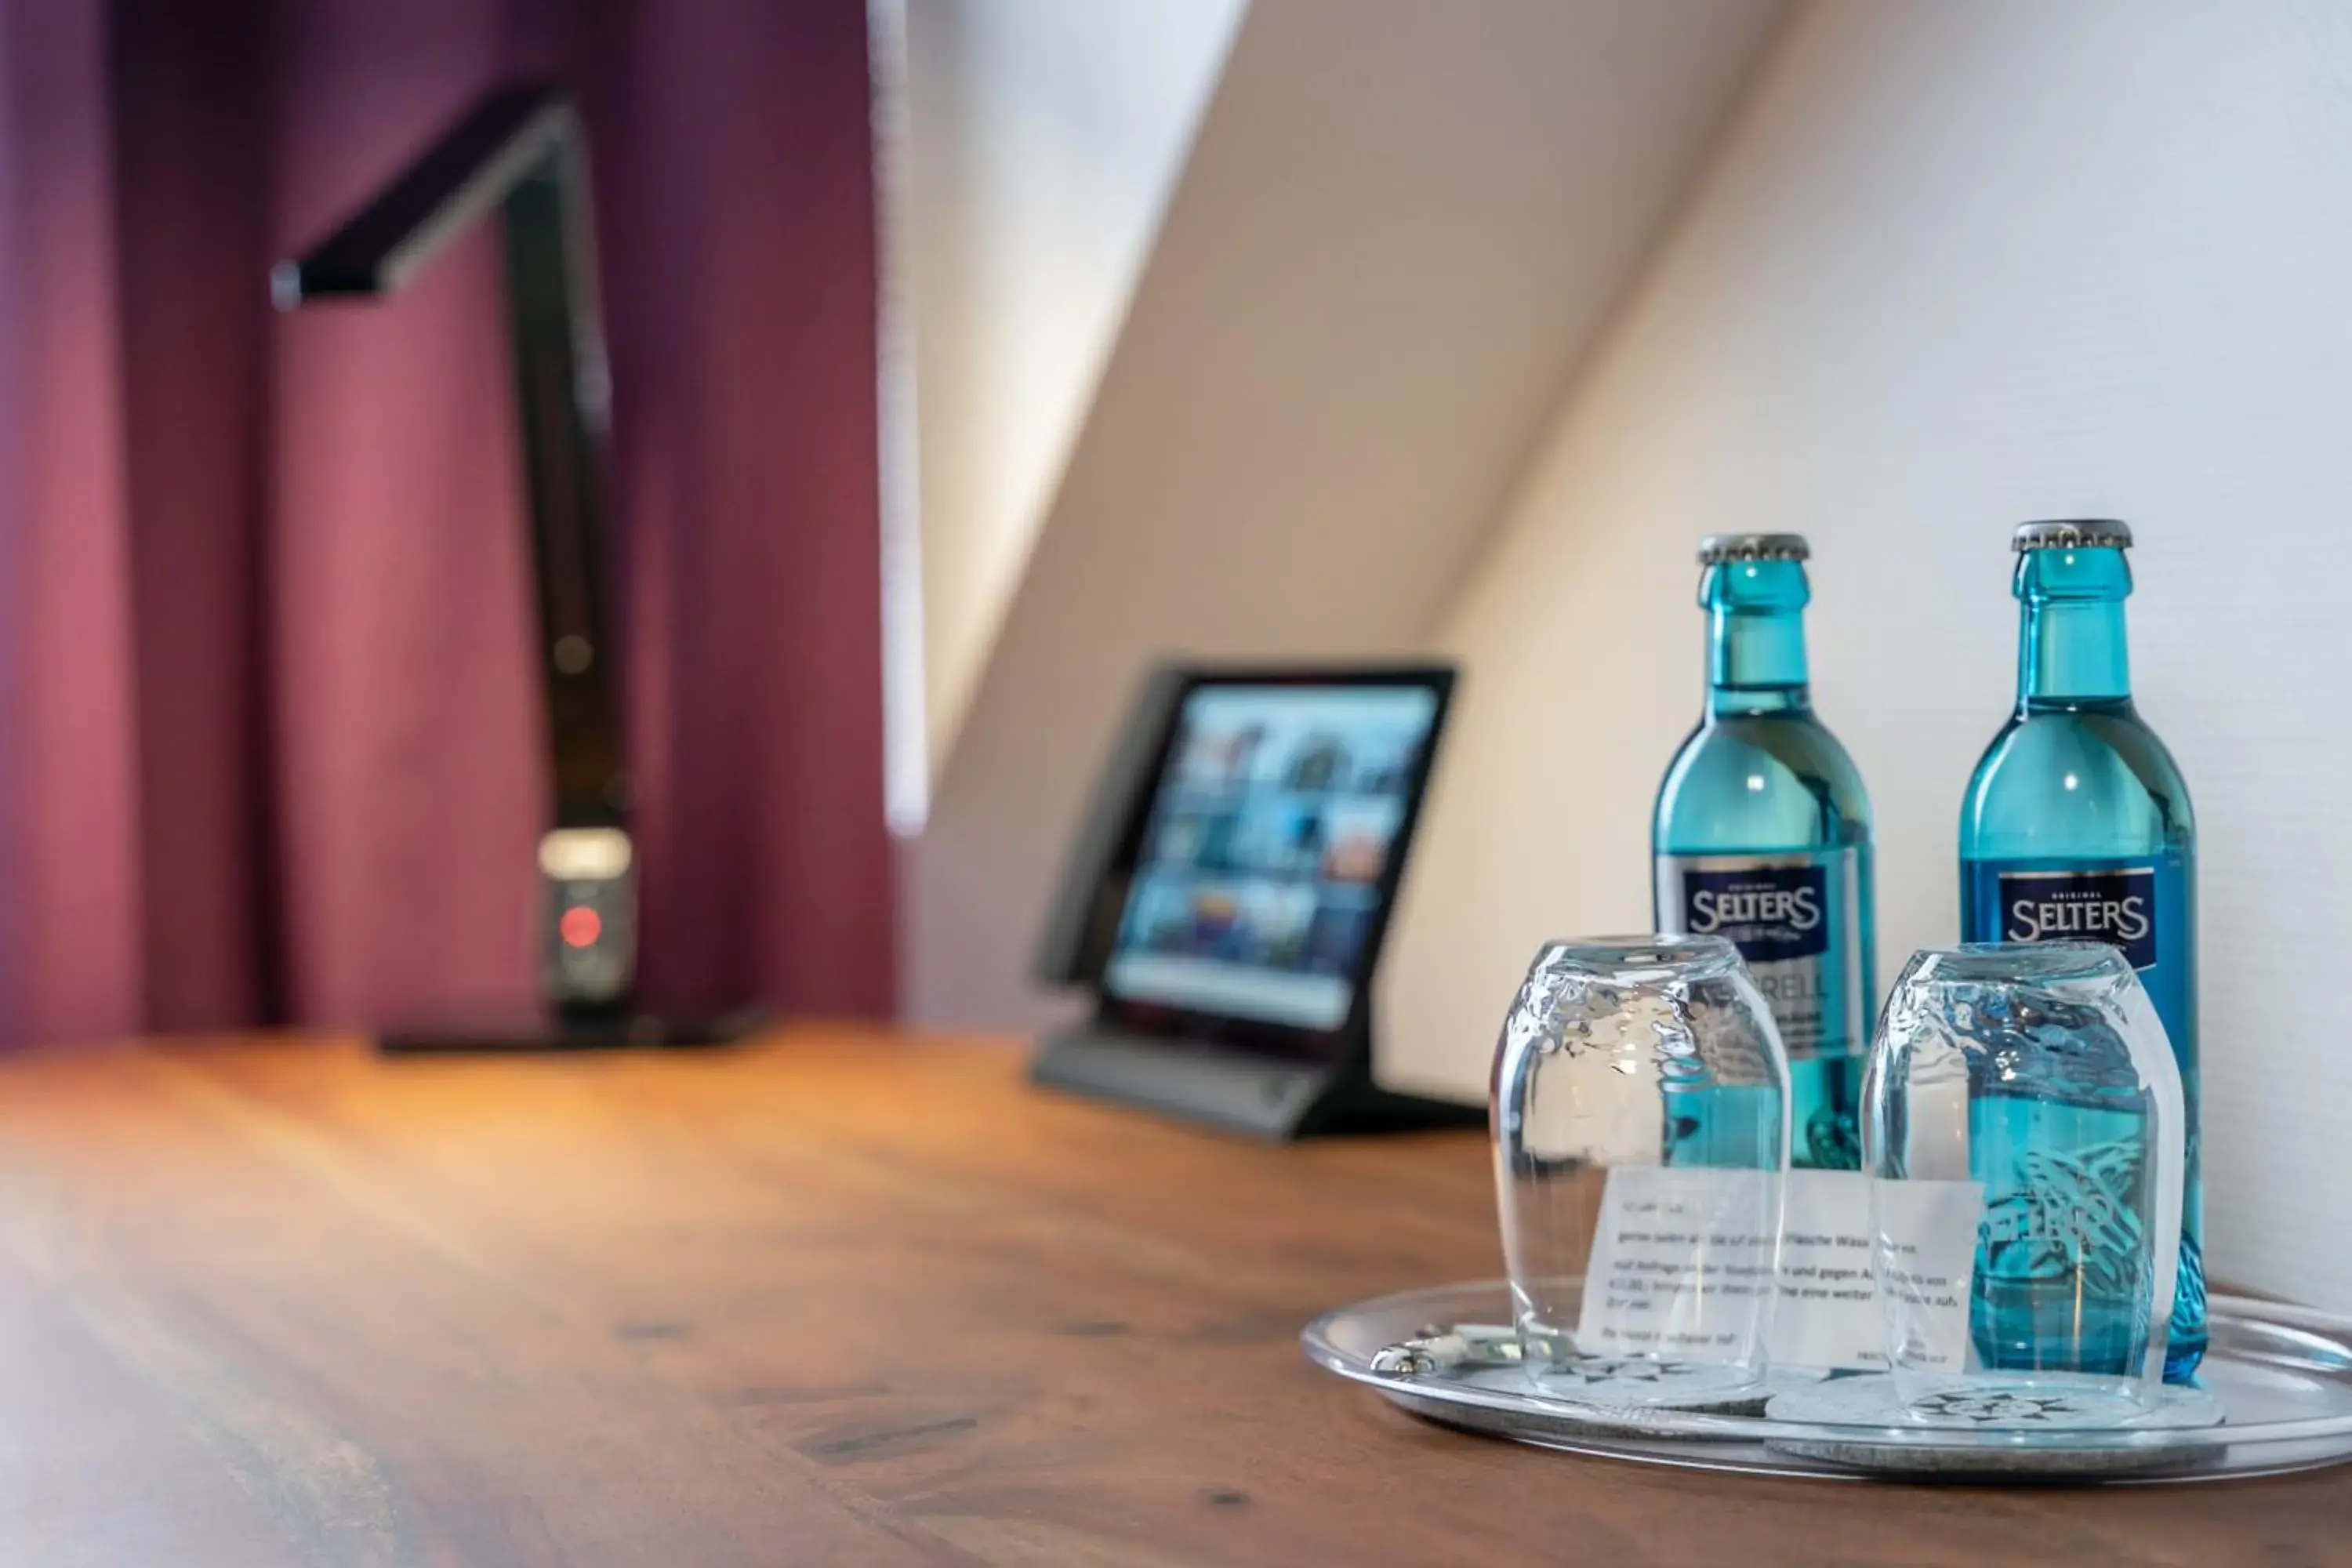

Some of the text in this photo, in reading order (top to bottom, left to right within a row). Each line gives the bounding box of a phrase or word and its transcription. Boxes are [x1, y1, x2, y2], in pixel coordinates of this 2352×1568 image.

[1690, 885, 1820, 933] SELTERS
[2008, 895, 2149, 942] SELTERS
[1756, 974, 1831, 1001] RELL
